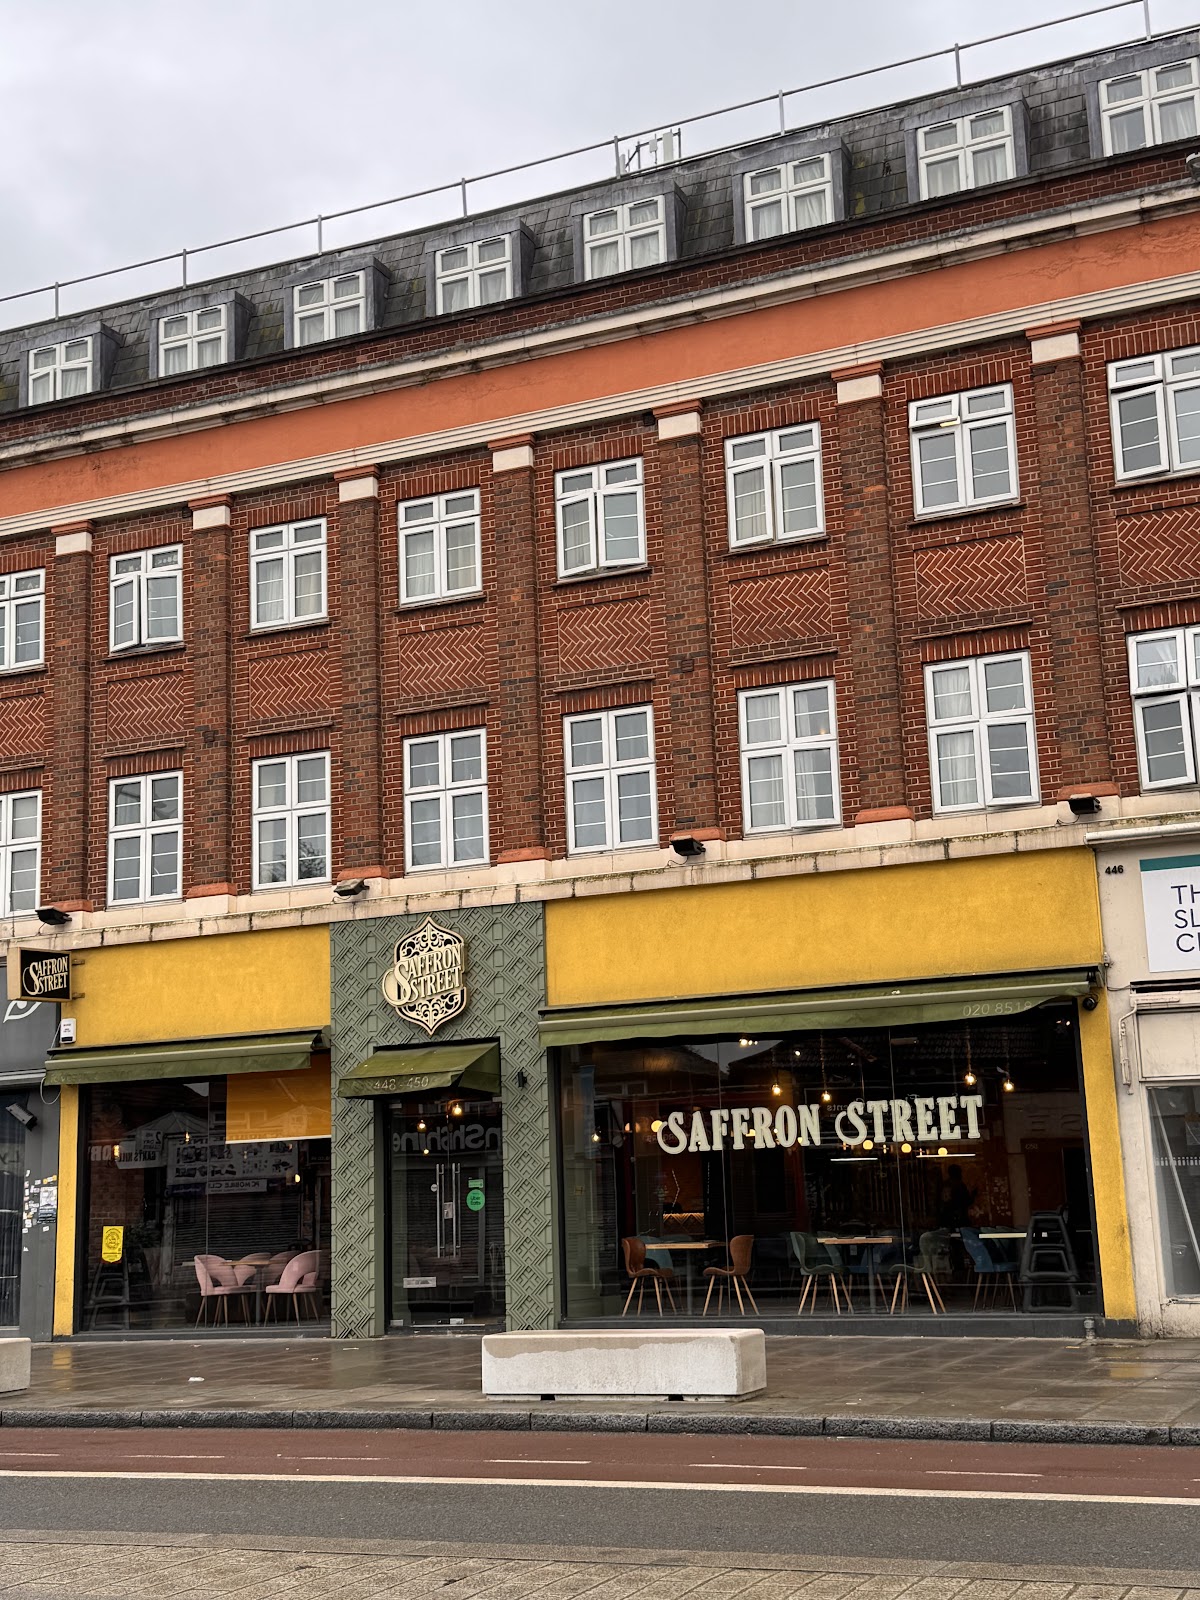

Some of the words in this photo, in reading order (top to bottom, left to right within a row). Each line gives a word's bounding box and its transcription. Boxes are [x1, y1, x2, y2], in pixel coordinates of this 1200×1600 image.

[1105, 865, 1124, 875] 446
[1176, 932, 1200, 953] C
[23, 955, 69, 995] SAFFRON
[38, 972, 68, 994] STREET
[382, 945, 461, 1005] SAFFRON
[407, 966, 461, 1002] STREET
[963, 1004, 990, 1017] 020
[406, 1075, 429, 1088] 450
[656, 1103, 821, 1154] SAFFRON
[835, 1094, 982, 1145] STREET
